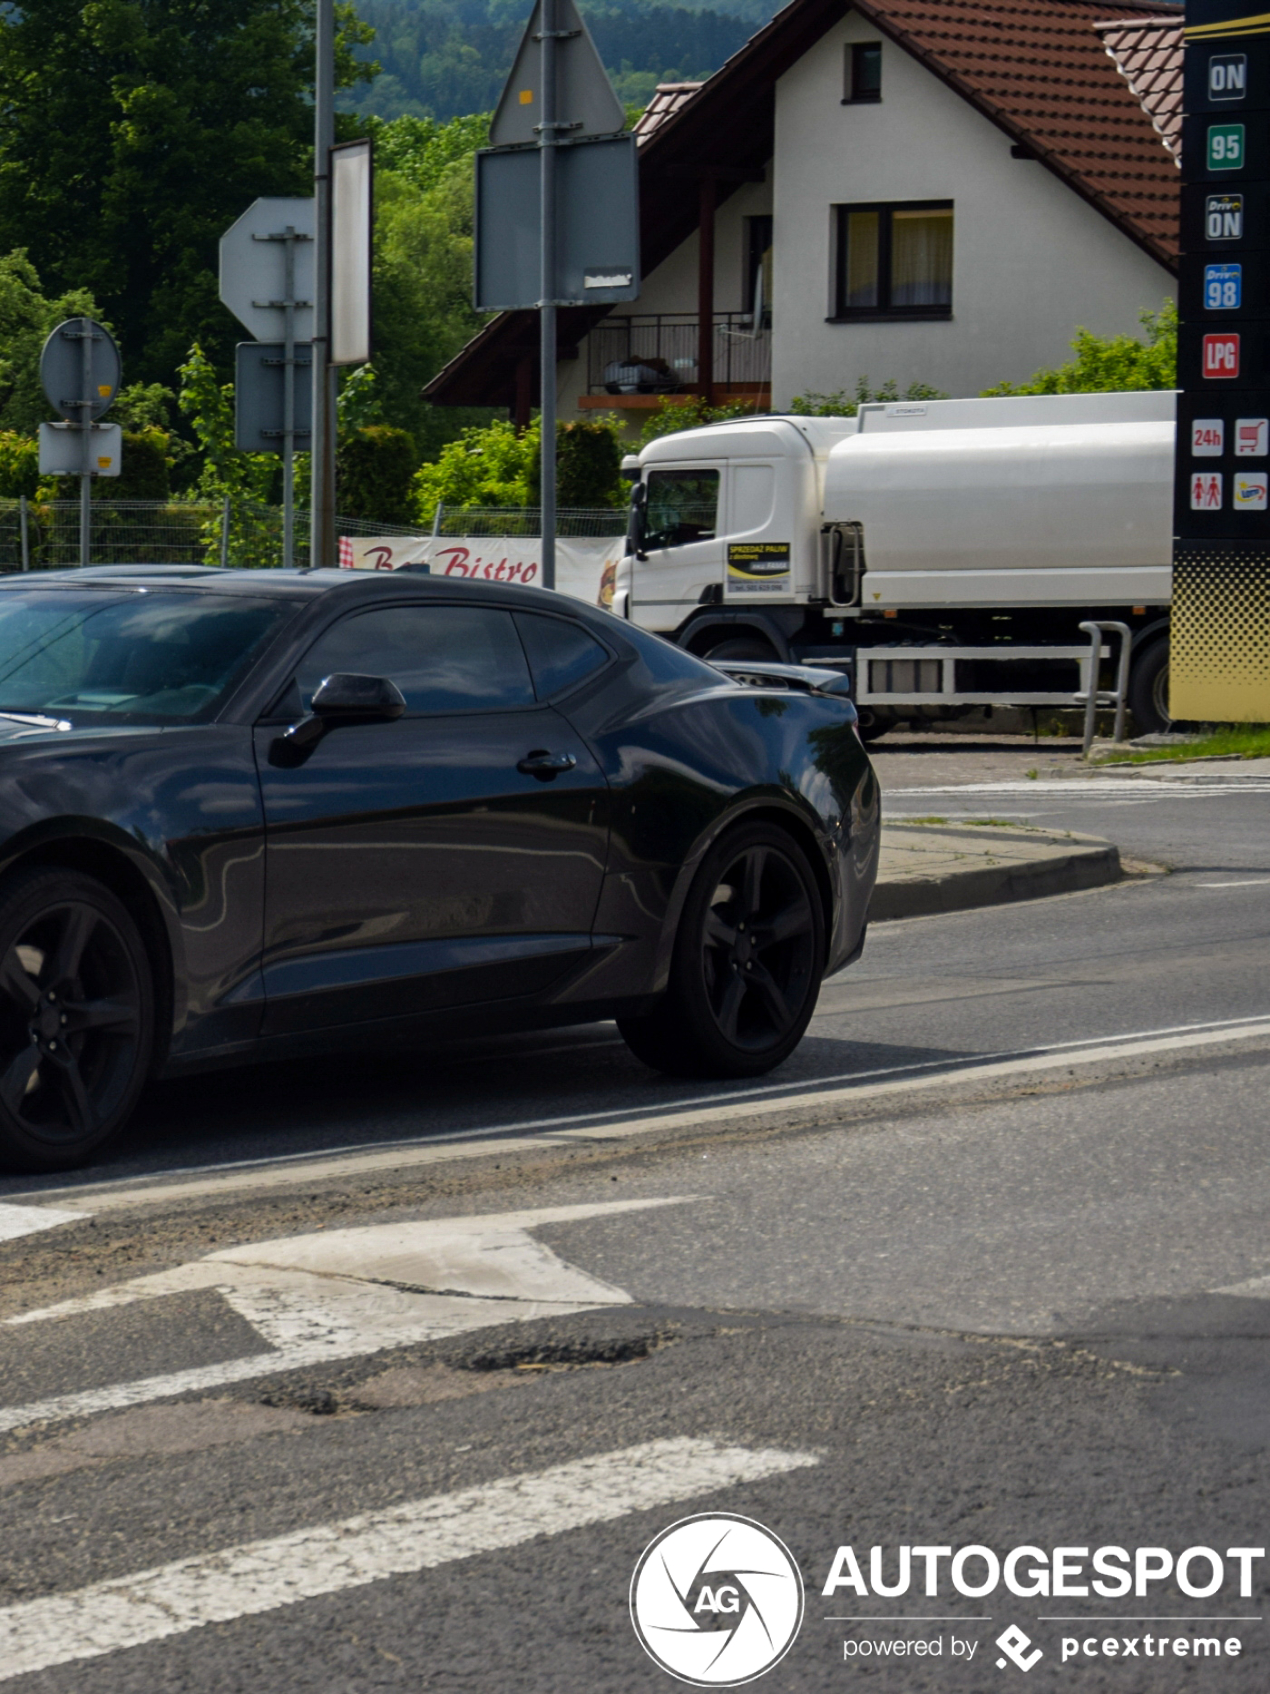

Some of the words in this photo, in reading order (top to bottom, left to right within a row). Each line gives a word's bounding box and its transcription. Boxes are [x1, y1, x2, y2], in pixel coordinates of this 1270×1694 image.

[1210, 63, 1244, 91] ON
[1212, 135, 1240, 160] 95
[1209, 212, 1240, 237] ON
[1208, 282, 1236, 307] 98
[1207, 342, 1235, 369] LPG
[1194, 429, 1221, 446] 24h
[435, 547, 538, 583] Bistro
